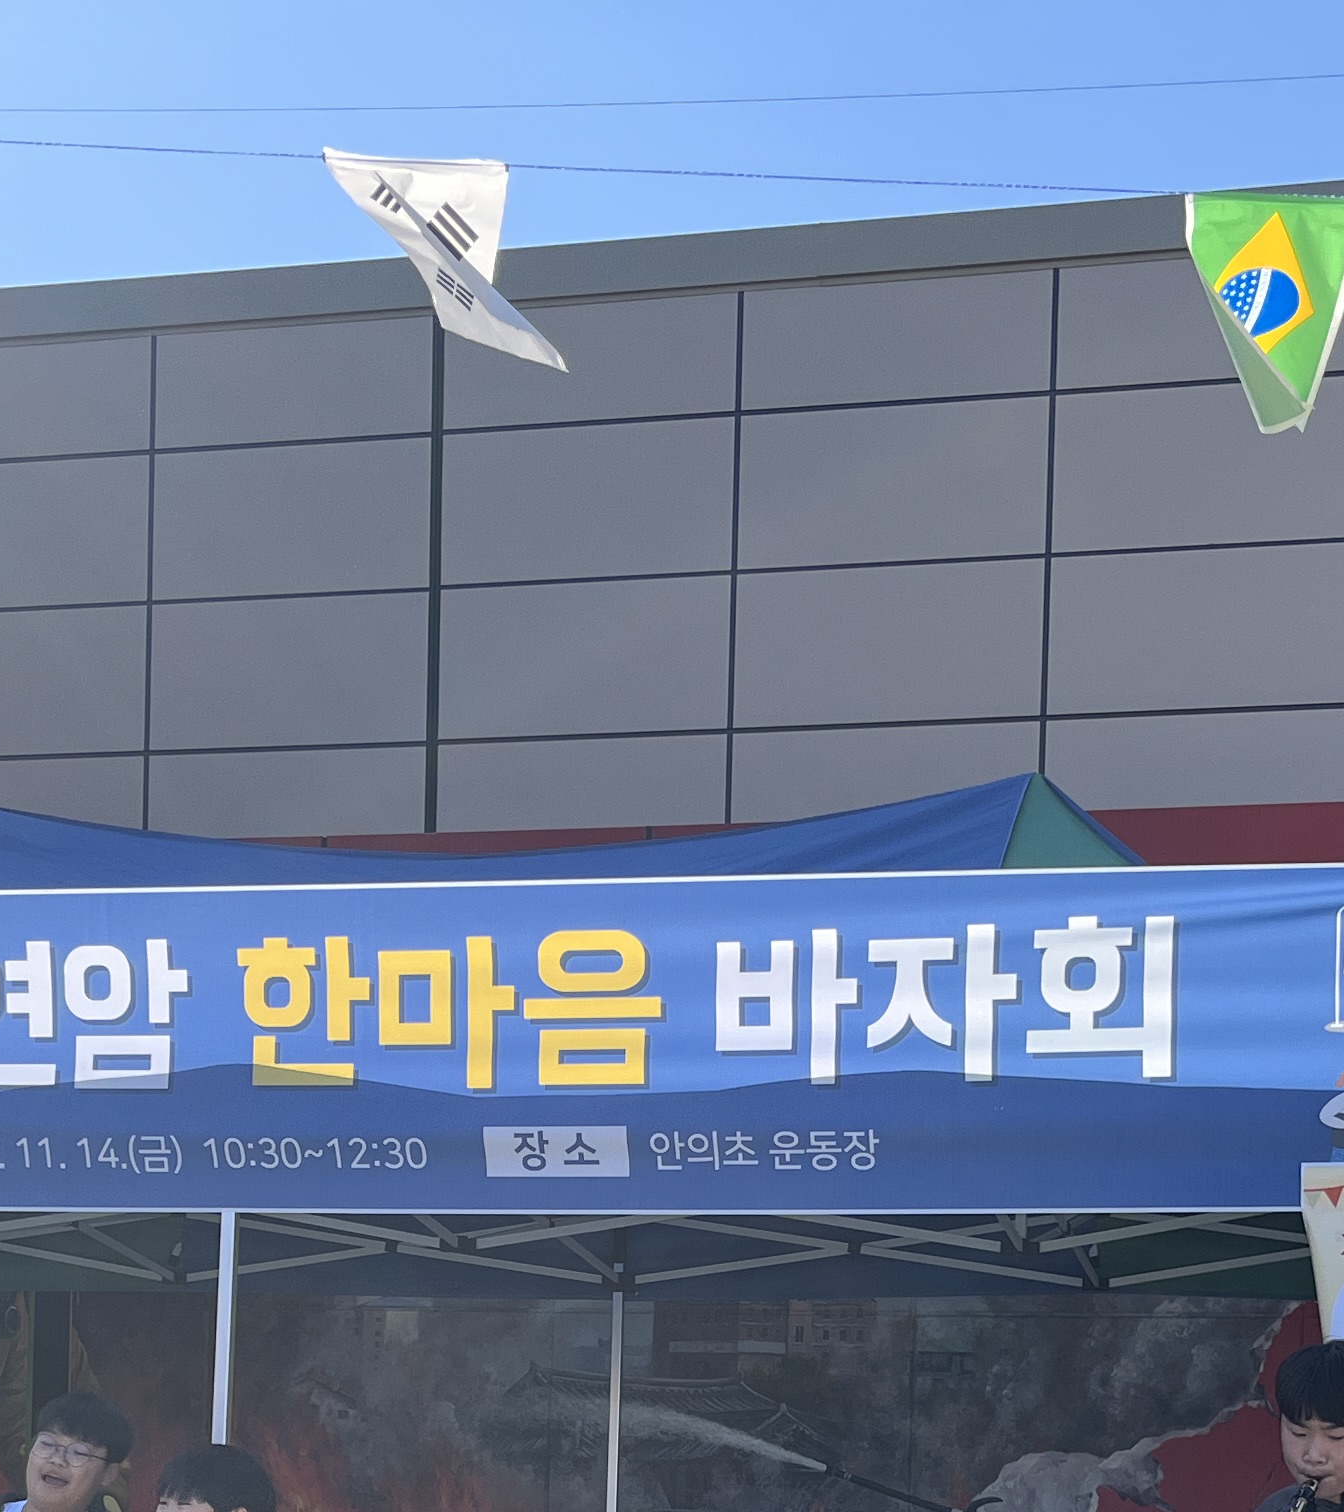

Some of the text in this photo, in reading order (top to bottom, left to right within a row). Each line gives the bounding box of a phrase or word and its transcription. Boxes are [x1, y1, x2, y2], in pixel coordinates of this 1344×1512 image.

[237, 928, 663, 1091] 한마음
[714, 914, 1176, 1087] 바자회
[16, 1136, 69, 1171] 11.
[205, 1136, 428, 1172] 10:30~12:30
[649, 1129, 759, 1172] 안의초
[769, 1127, 879, 1170] 운동장
